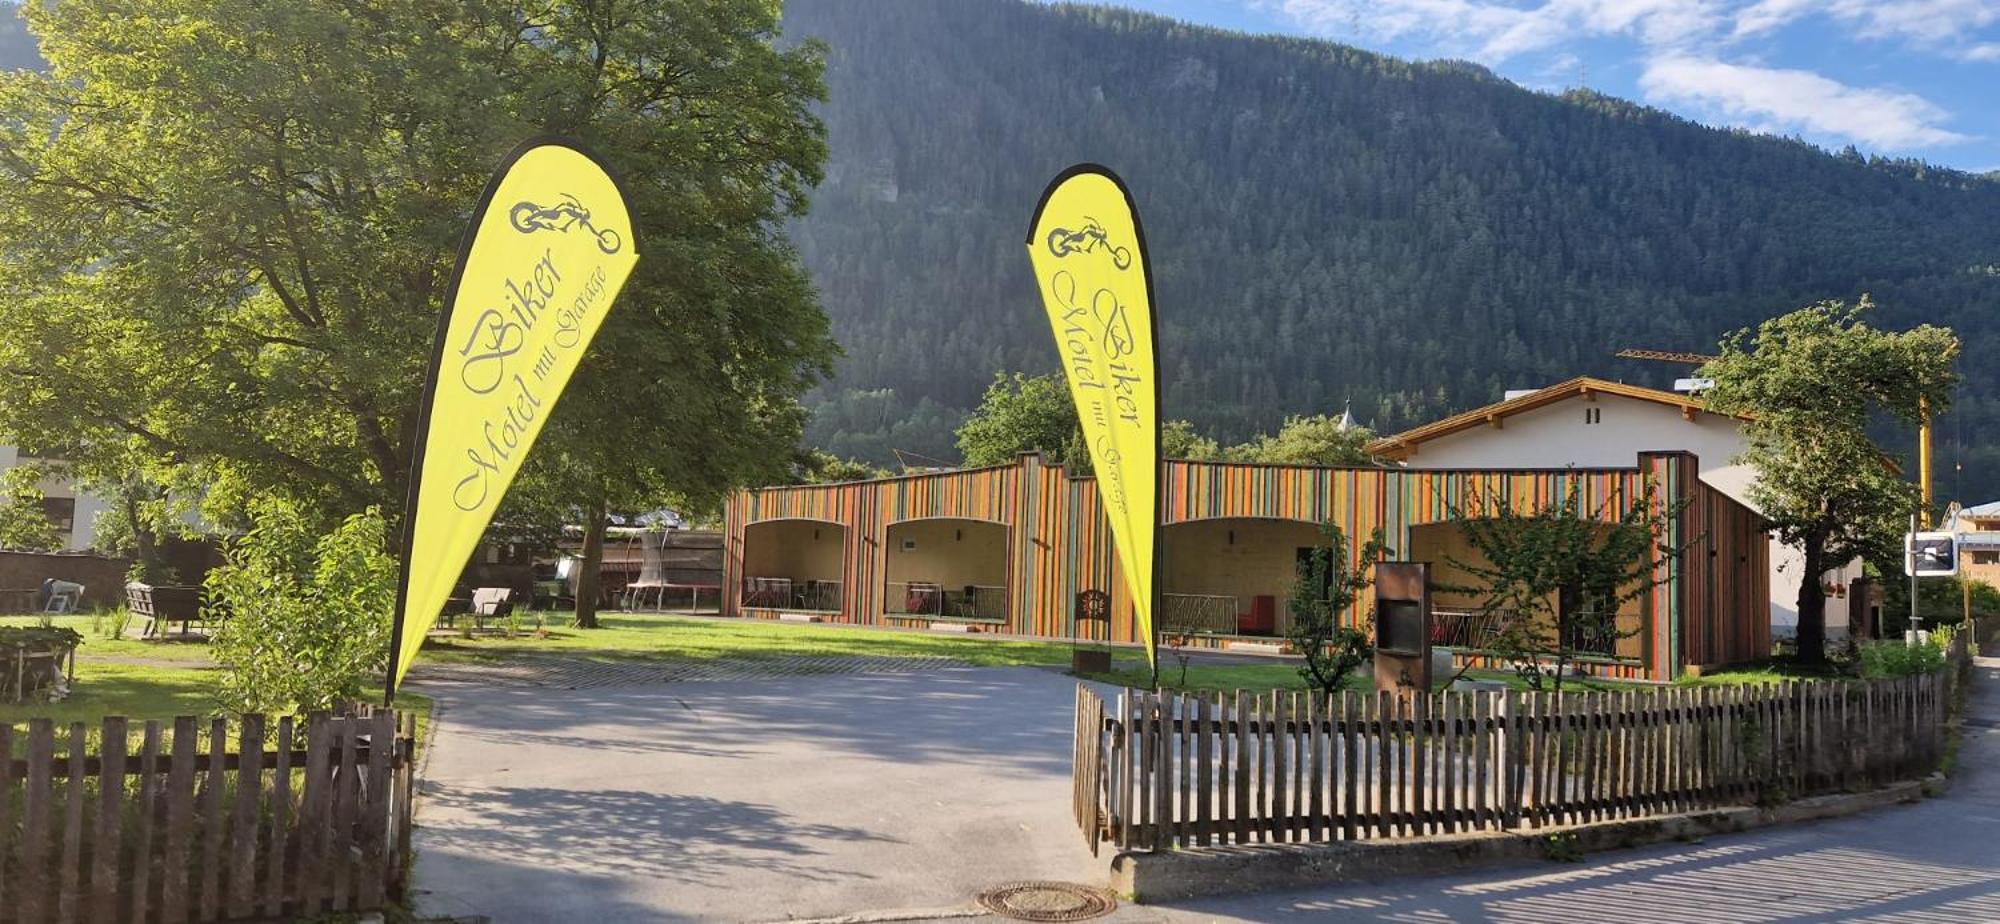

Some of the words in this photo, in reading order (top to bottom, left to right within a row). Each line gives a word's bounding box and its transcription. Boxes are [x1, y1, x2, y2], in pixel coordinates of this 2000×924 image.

[453, 374, 541, 511] Motel
[533, 345, 557, 381] mit
[554, 265, 607, 349] Garage
[459, 248, 561, 394] Biker
[1052, 270, 1106, 389] Motel
[1093, 288, 1141, 428] Biker
